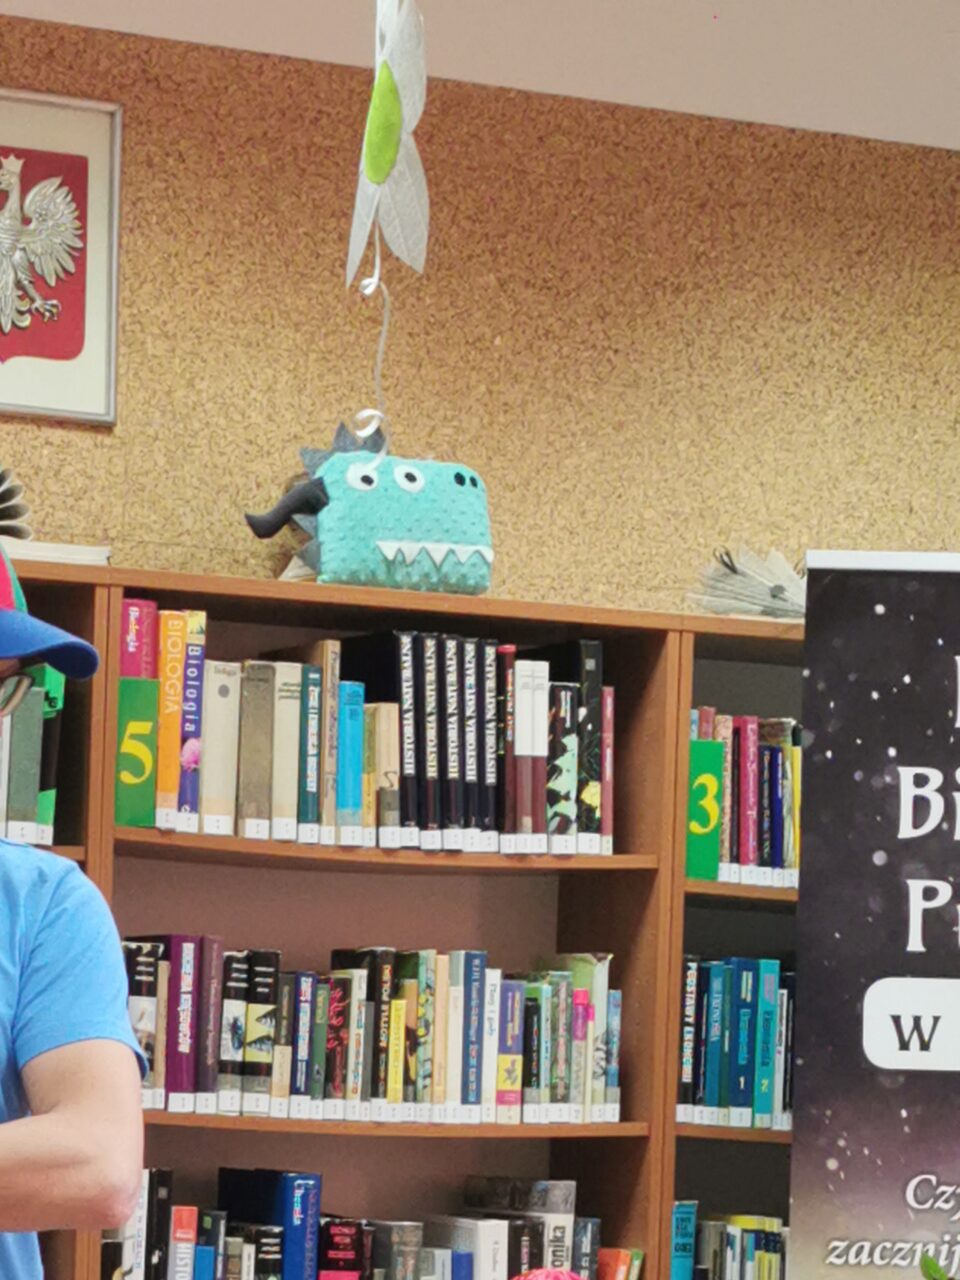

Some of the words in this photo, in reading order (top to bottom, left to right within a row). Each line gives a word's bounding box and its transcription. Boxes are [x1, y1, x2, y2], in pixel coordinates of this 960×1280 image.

[163, 619, 184, 714] BIOLOGIA
[183, 646, 202, 732] Biologia
[119, 721, 153, 785] 5
[403, 711, 415, 776] HISTORIA
[426, 714, 438, 779] HISTORIA
[447, 715, 459, 780] HISTORIA
[465, 718, 477, 782] HISTORIA
[486, 721, 497, 786] HISTORIA
[689, 773, 720, 835] 3
[906, 879, 960, 952] P
